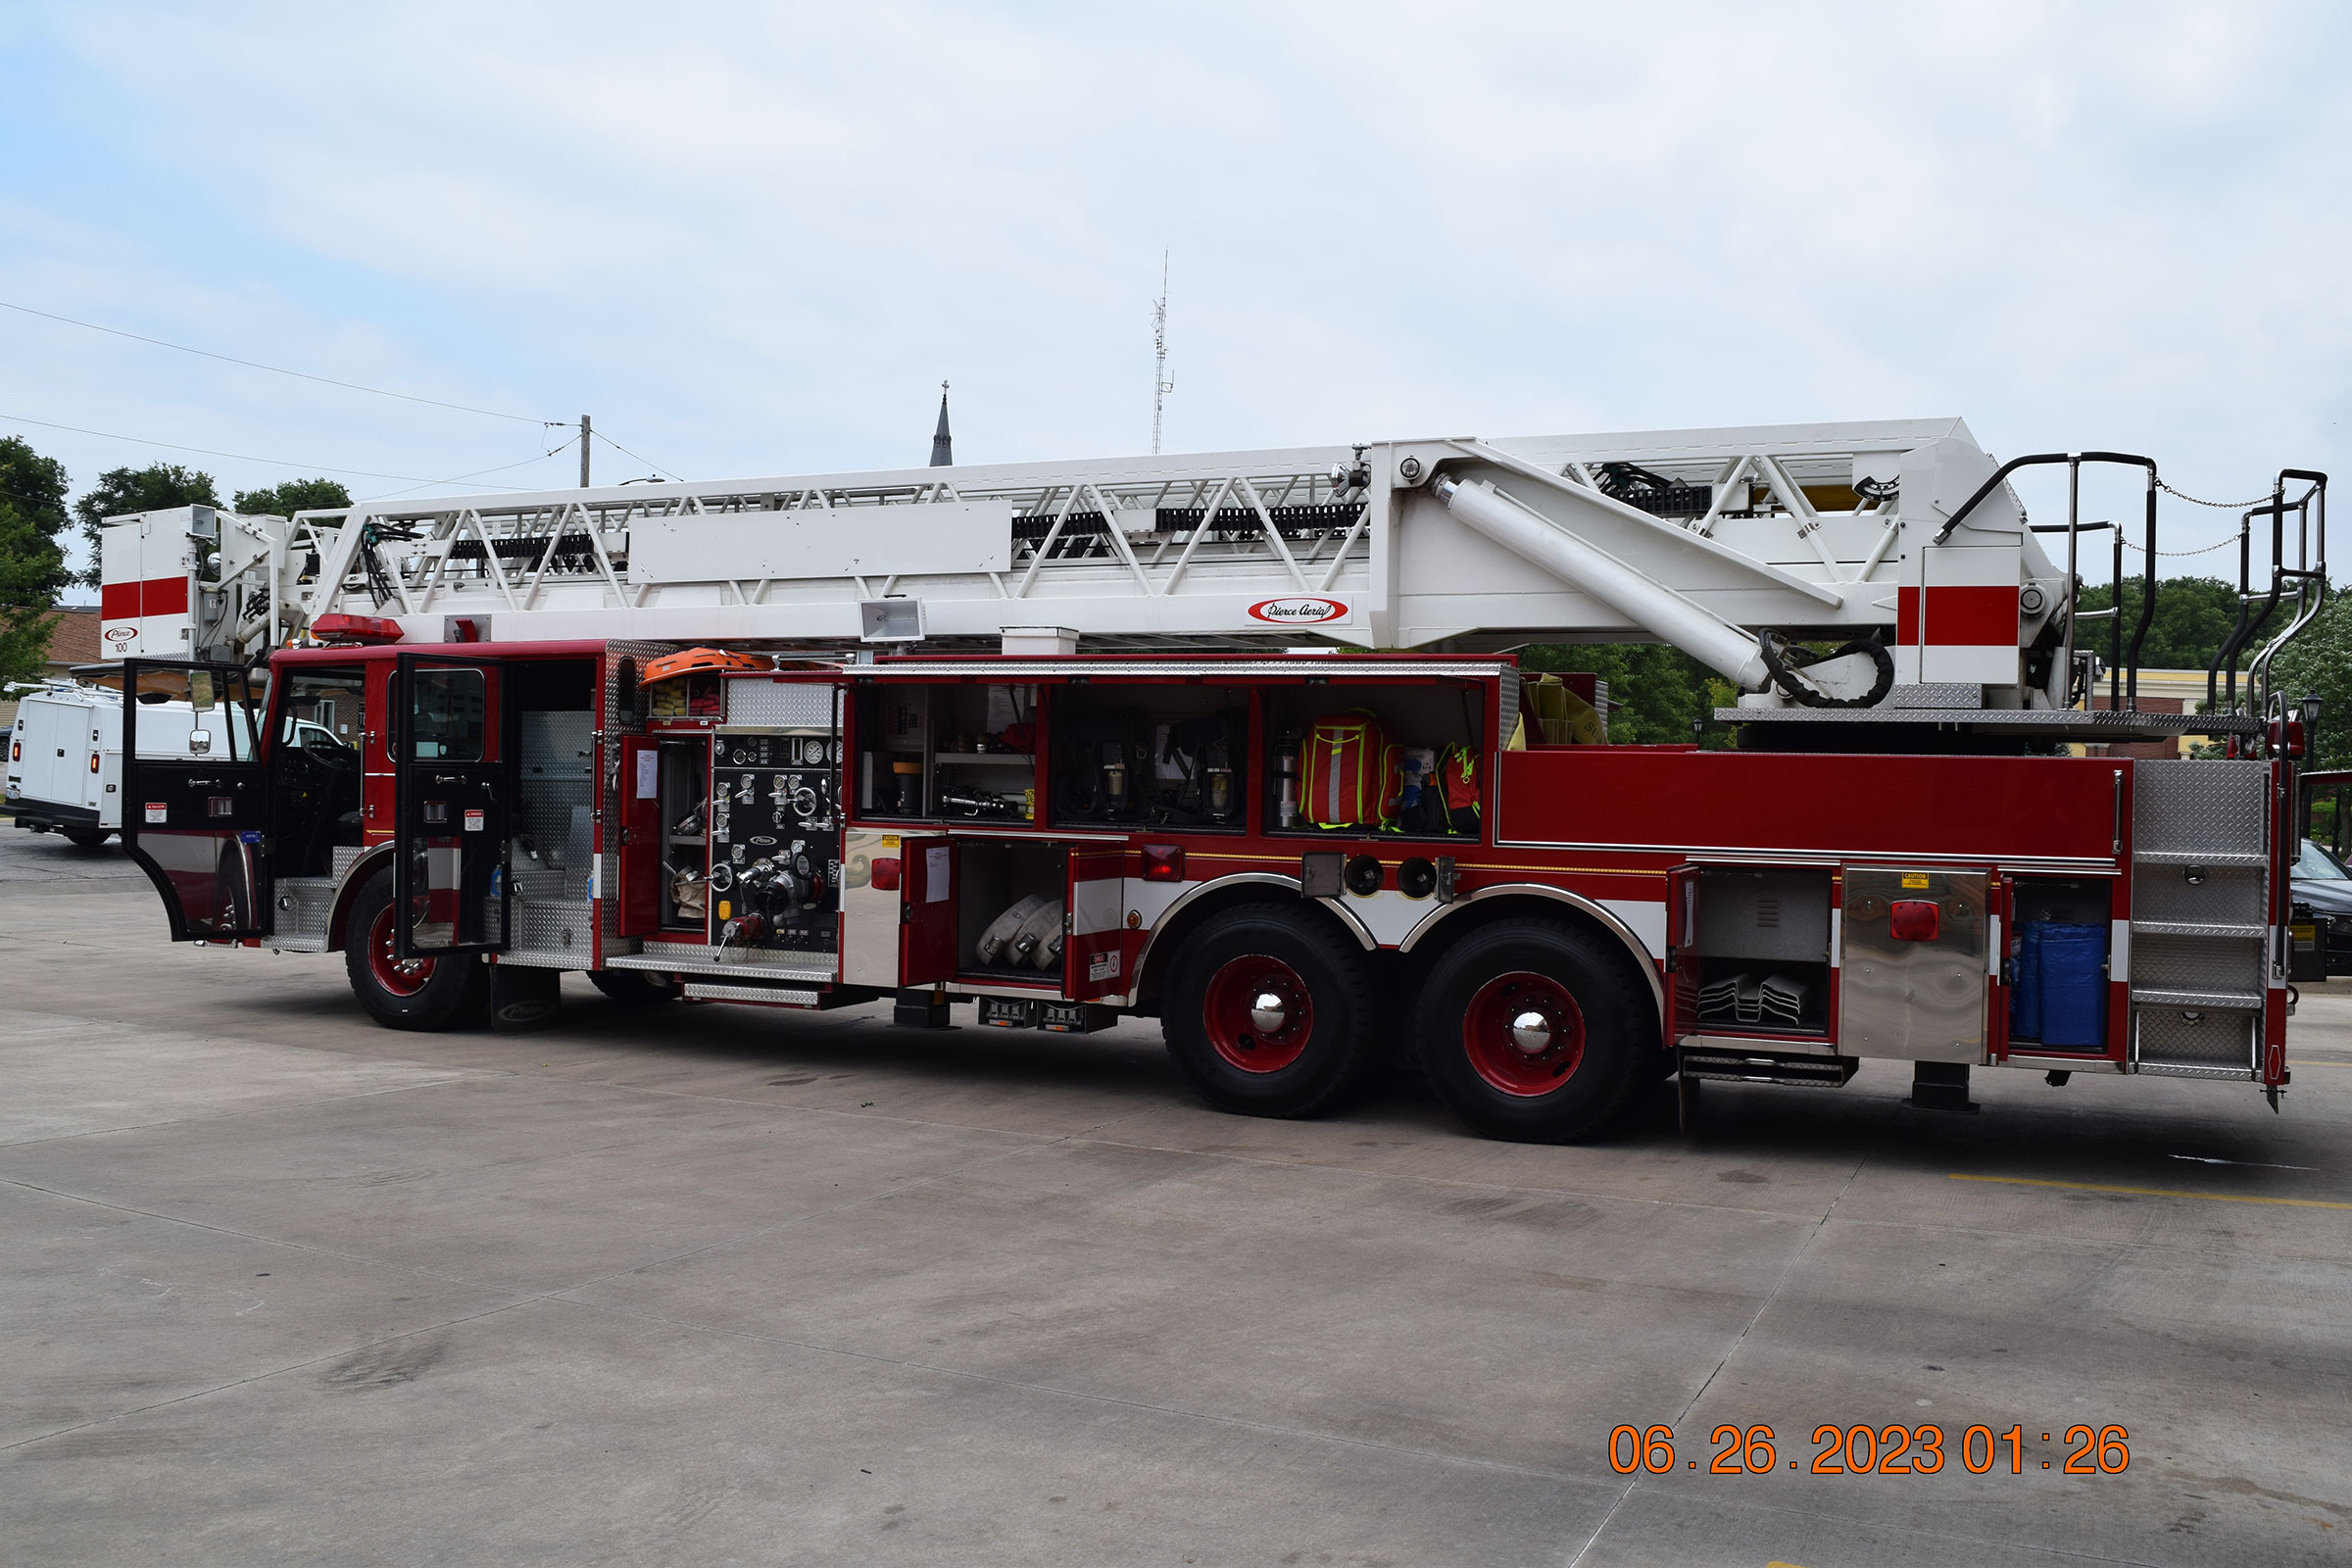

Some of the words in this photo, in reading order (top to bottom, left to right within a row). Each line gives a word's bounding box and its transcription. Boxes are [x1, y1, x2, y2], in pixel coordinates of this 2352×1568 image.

[1267, 602, 1297, 618] Pierce
[1298, 603, 1333, 618] Aerial
[115, 642, 127, 653] 100
